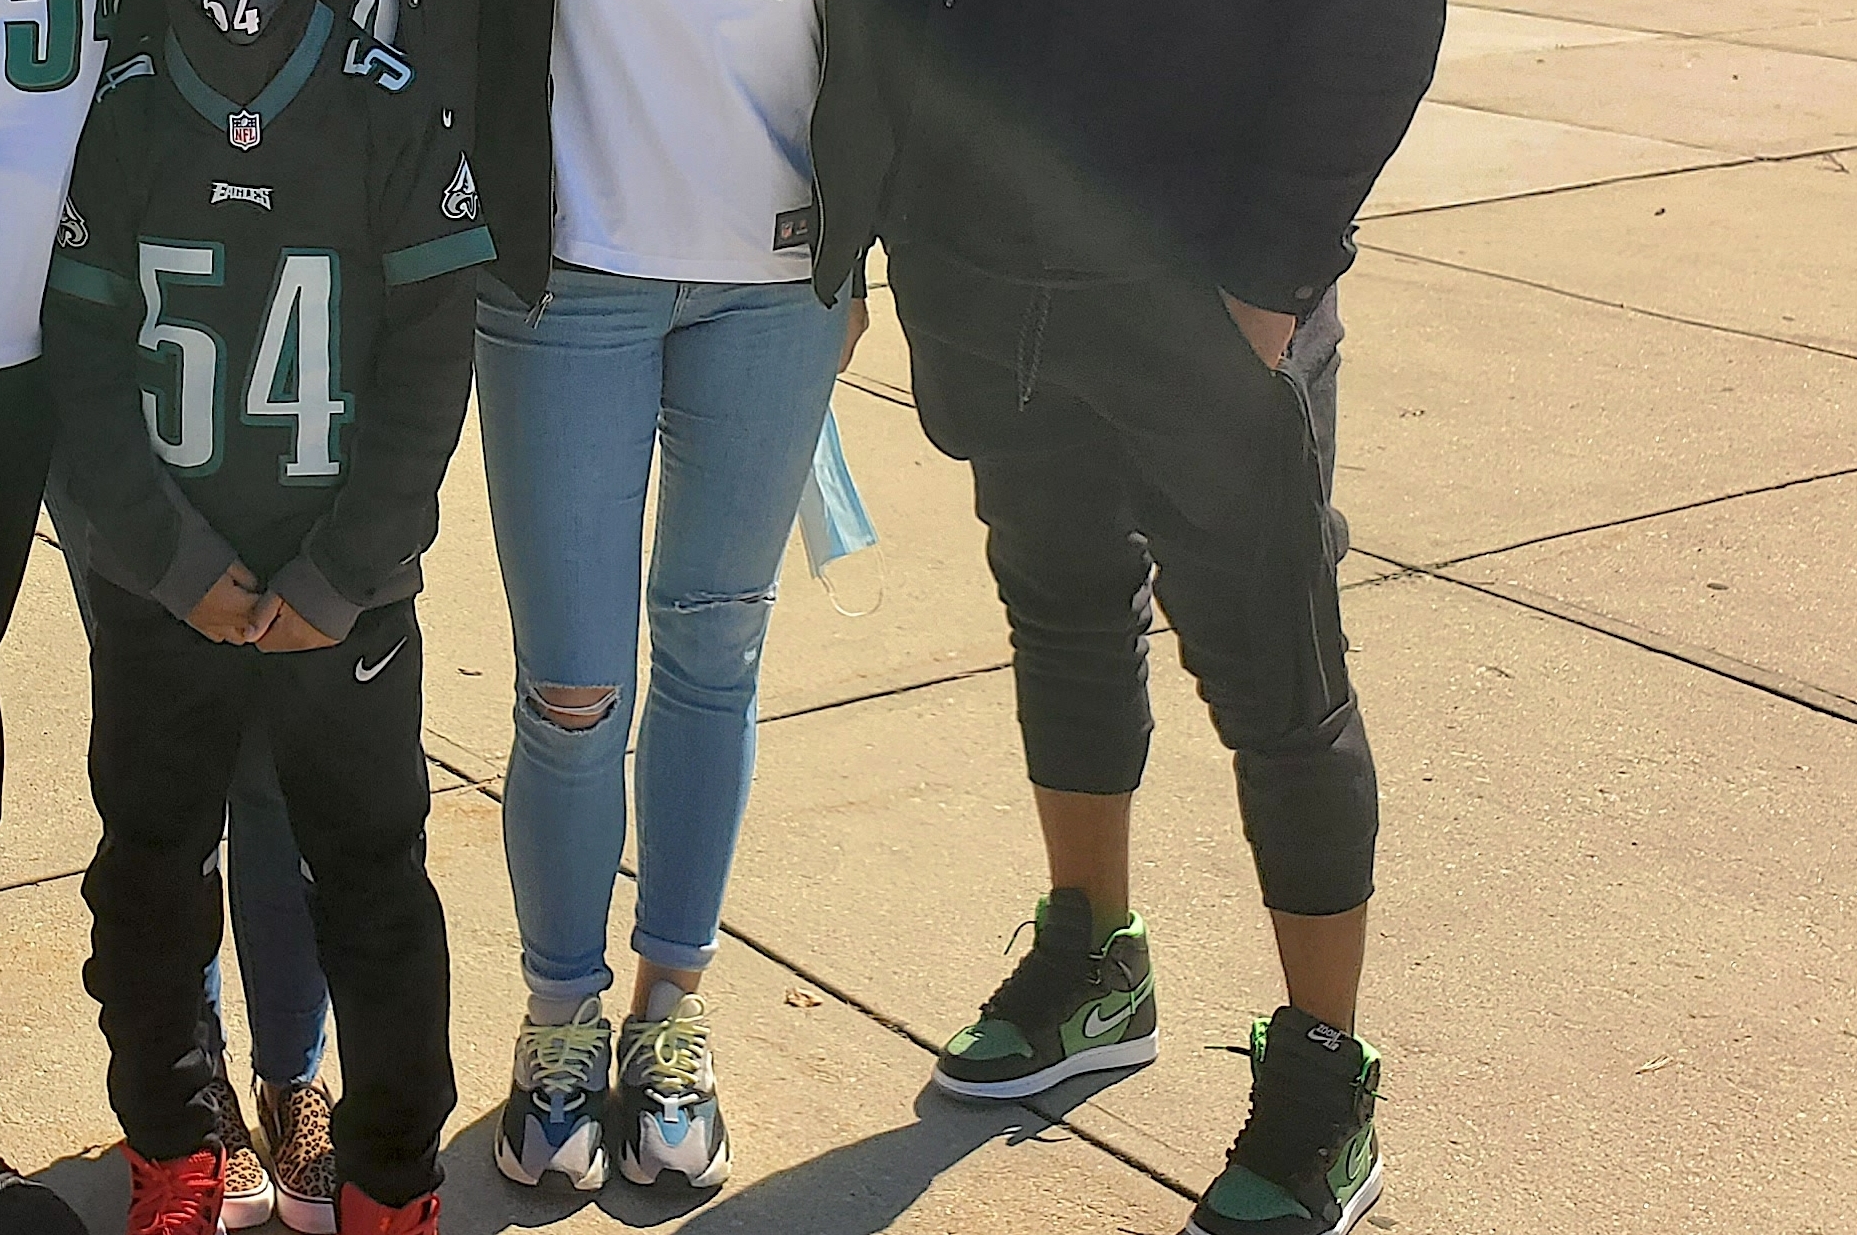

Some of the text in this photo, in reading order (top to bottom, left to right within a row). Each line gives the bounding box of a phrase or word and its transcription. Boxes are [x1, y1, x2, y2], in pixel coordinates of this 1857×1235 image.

[234, 127, 256, 143] NFL
[210, 182, 274, 211] EAGLES
[137, 236, 355, 487] 54
